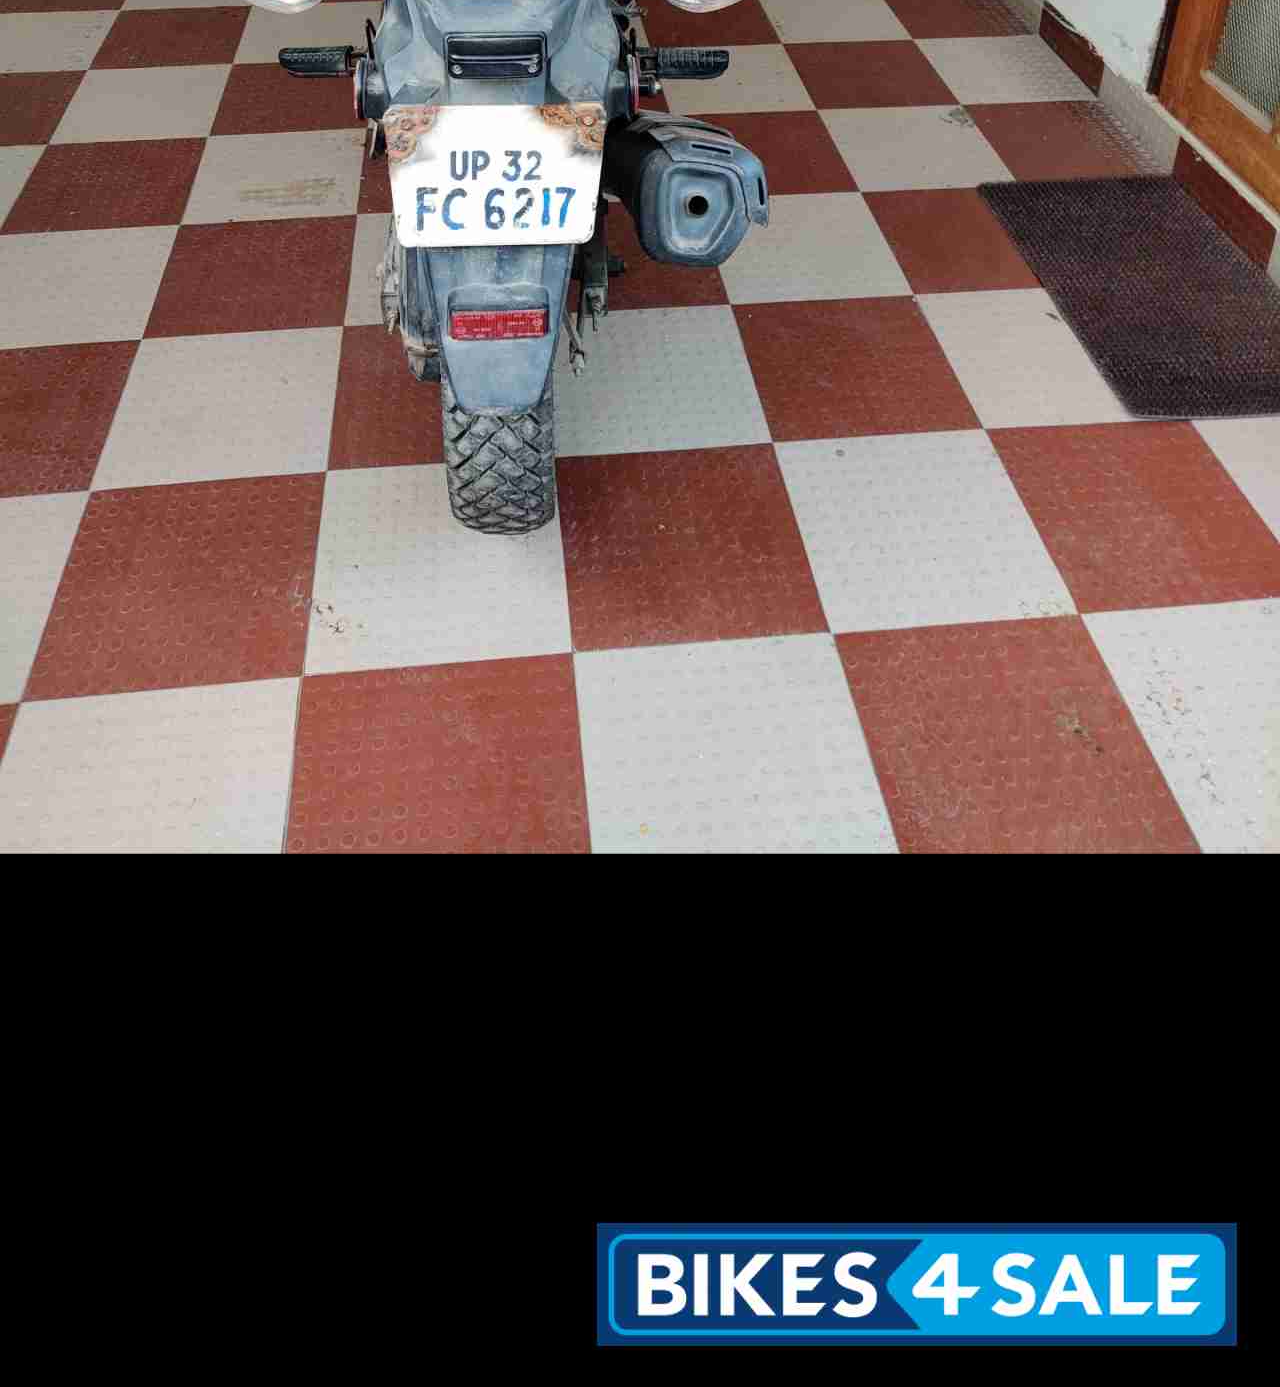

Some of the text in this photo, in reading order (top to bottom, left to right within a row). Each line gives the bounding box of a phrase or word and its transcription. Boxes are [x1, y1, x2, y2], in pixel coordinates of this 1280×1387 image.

[450, 150, 542, 182] UP 32
[415, 186, 577, 231] FC 6217
